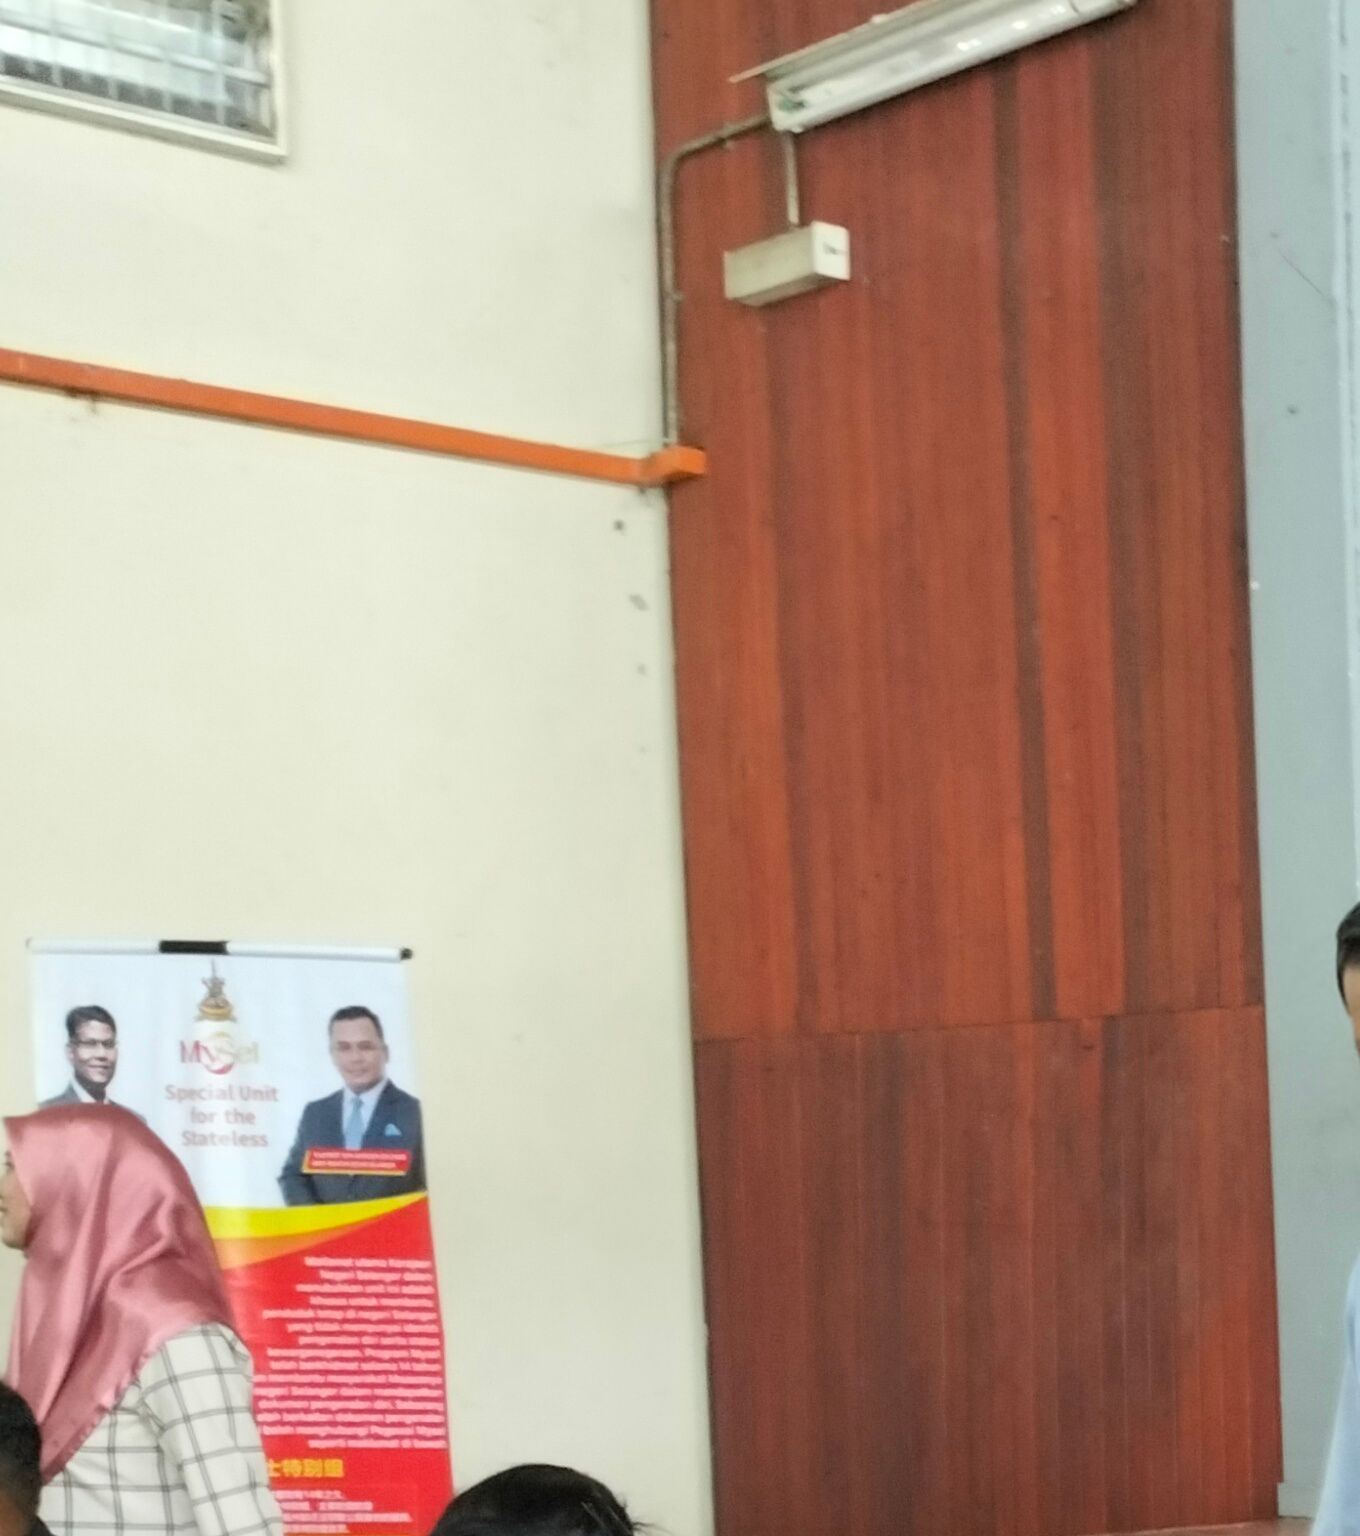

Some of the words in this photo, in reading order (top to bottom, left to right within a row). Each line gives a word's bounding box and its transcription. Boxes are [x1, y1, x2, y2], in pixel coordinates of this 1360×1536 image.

[164, 1084, 234, 1103] Special
[238, 1084, 280, 1102] Unit
[190, 1106, 217, 1124] for
[224, 1107, 257, 1124] the
[181, 1129, 270, 1148] Stateless
